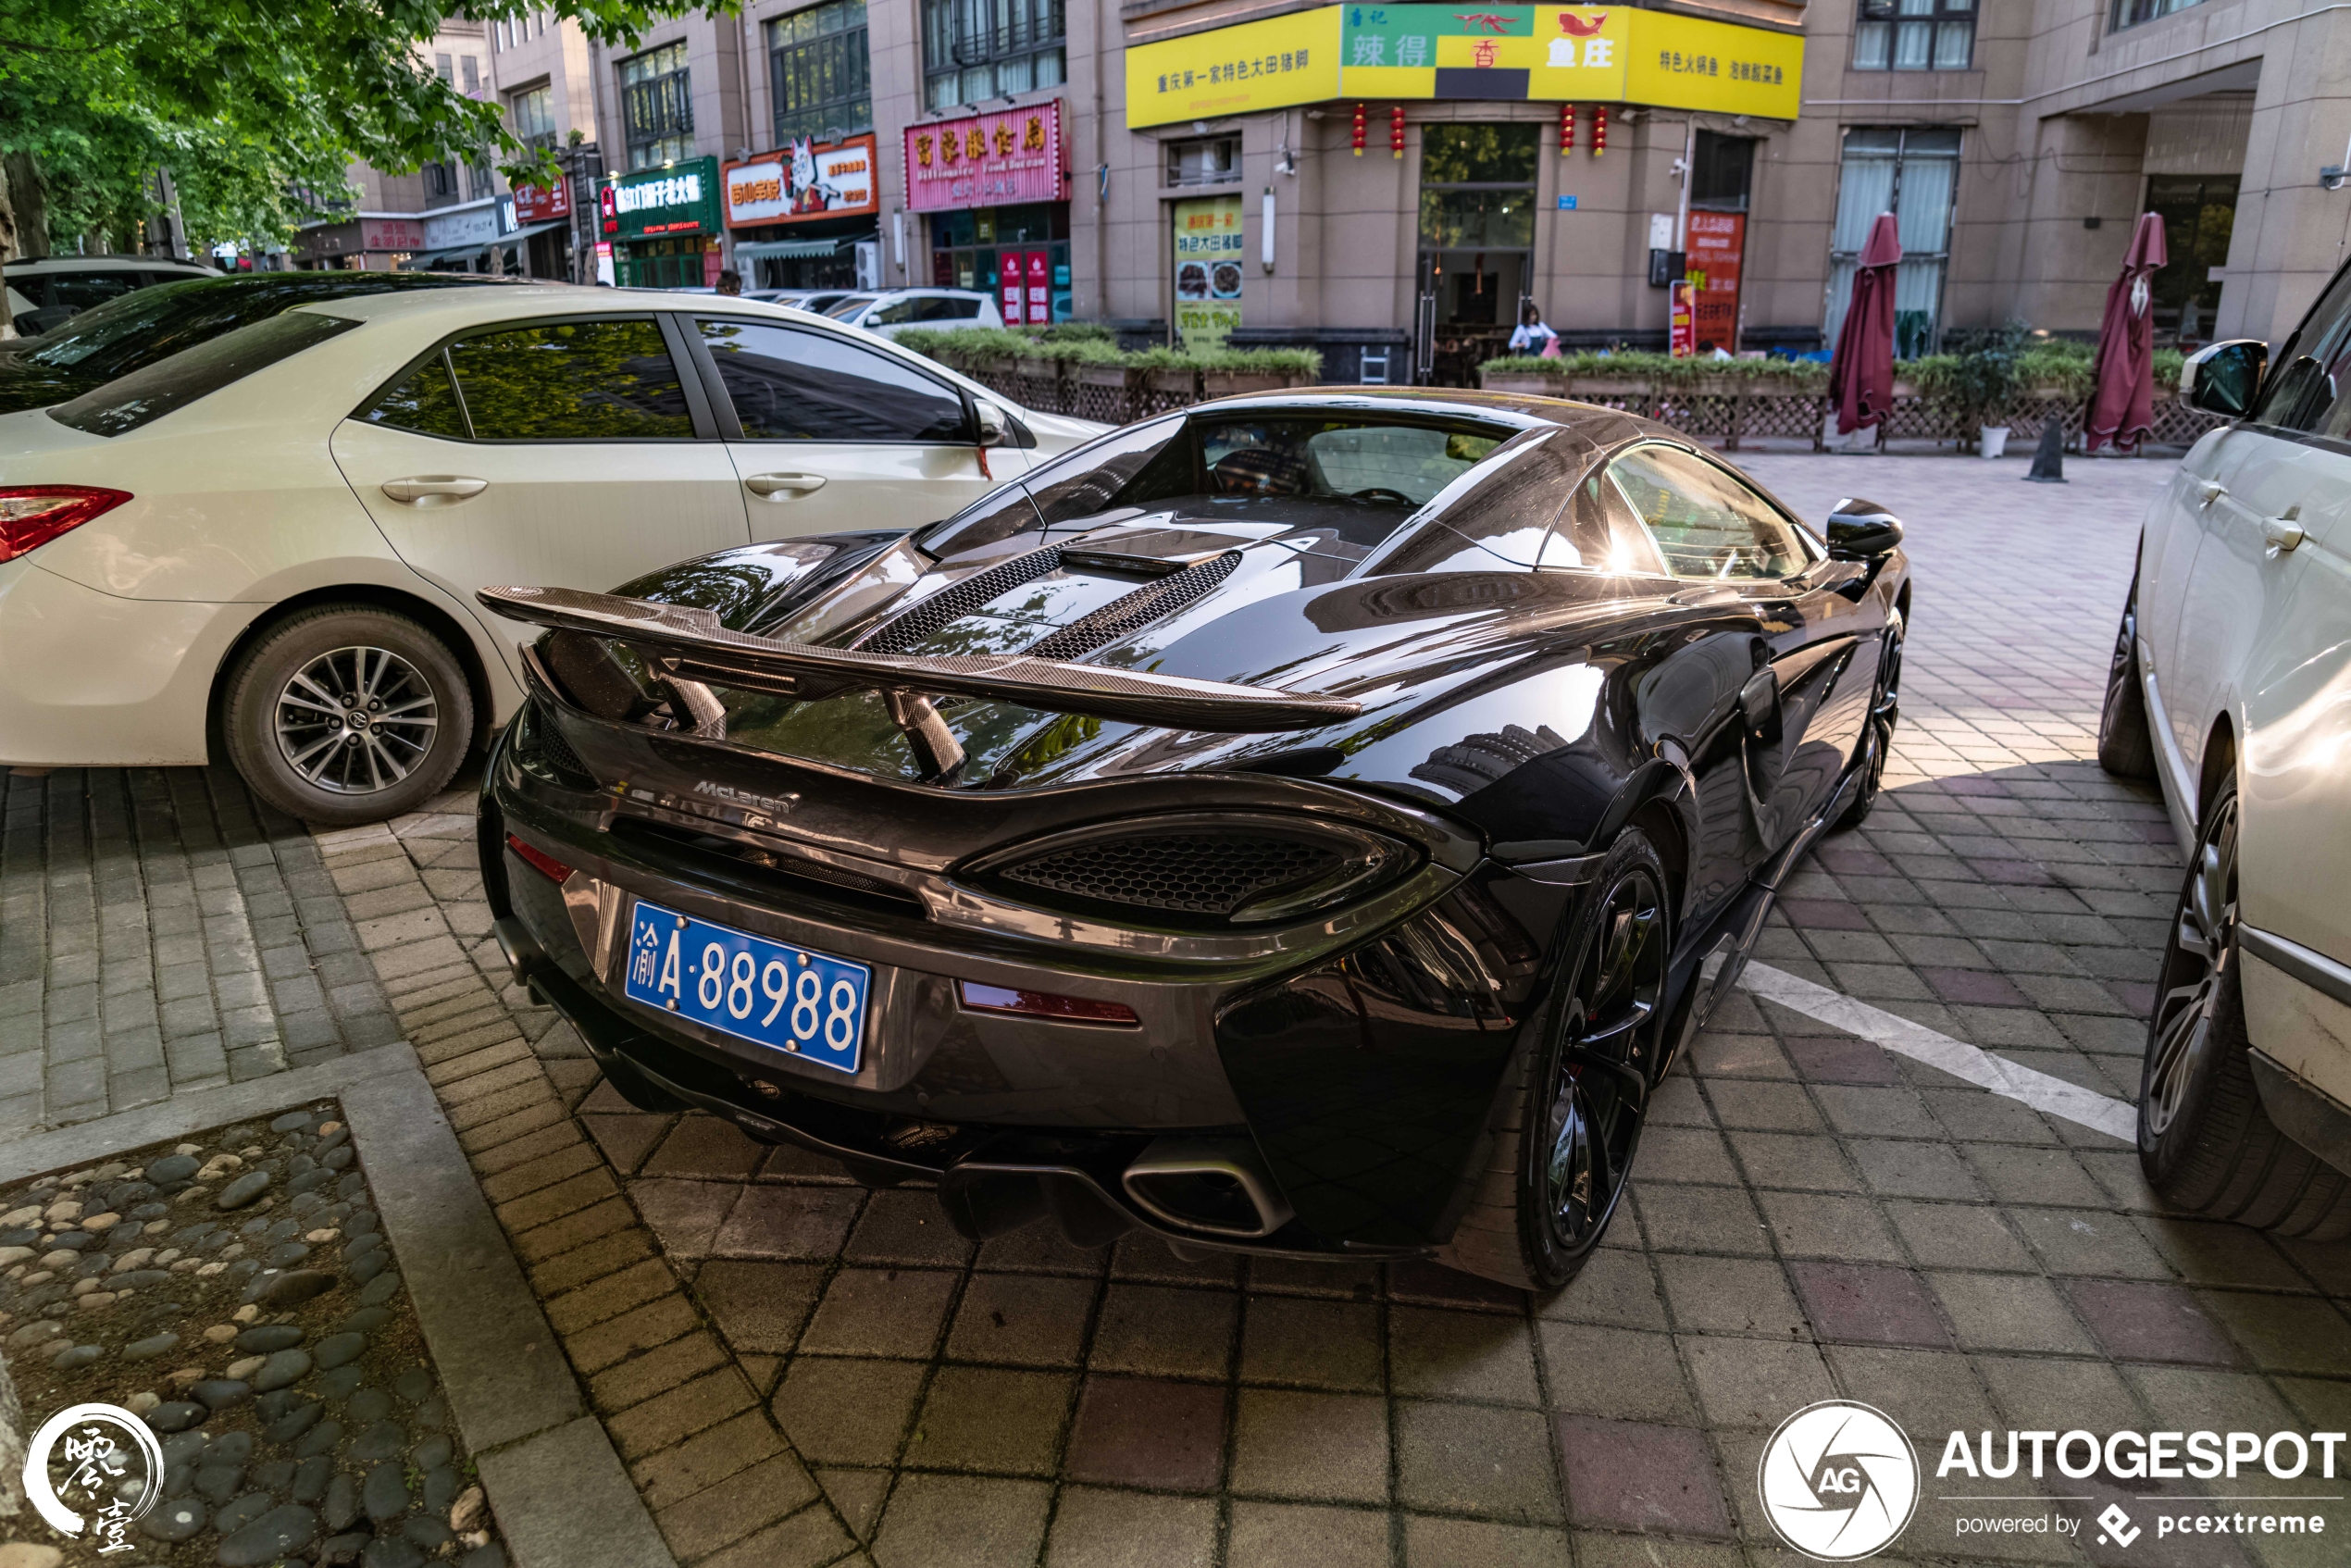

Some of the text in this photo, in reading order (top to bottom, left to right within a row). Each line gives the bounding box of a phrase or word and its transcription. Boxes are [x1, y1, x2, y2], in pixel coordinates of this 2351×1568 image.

[1158, 49, 1309, 93] 重庆第一家特色大田猪脚
[1660, 50, 1718, 77] 特色火锅鱼
[694, 780, 791, 813] McLaren
